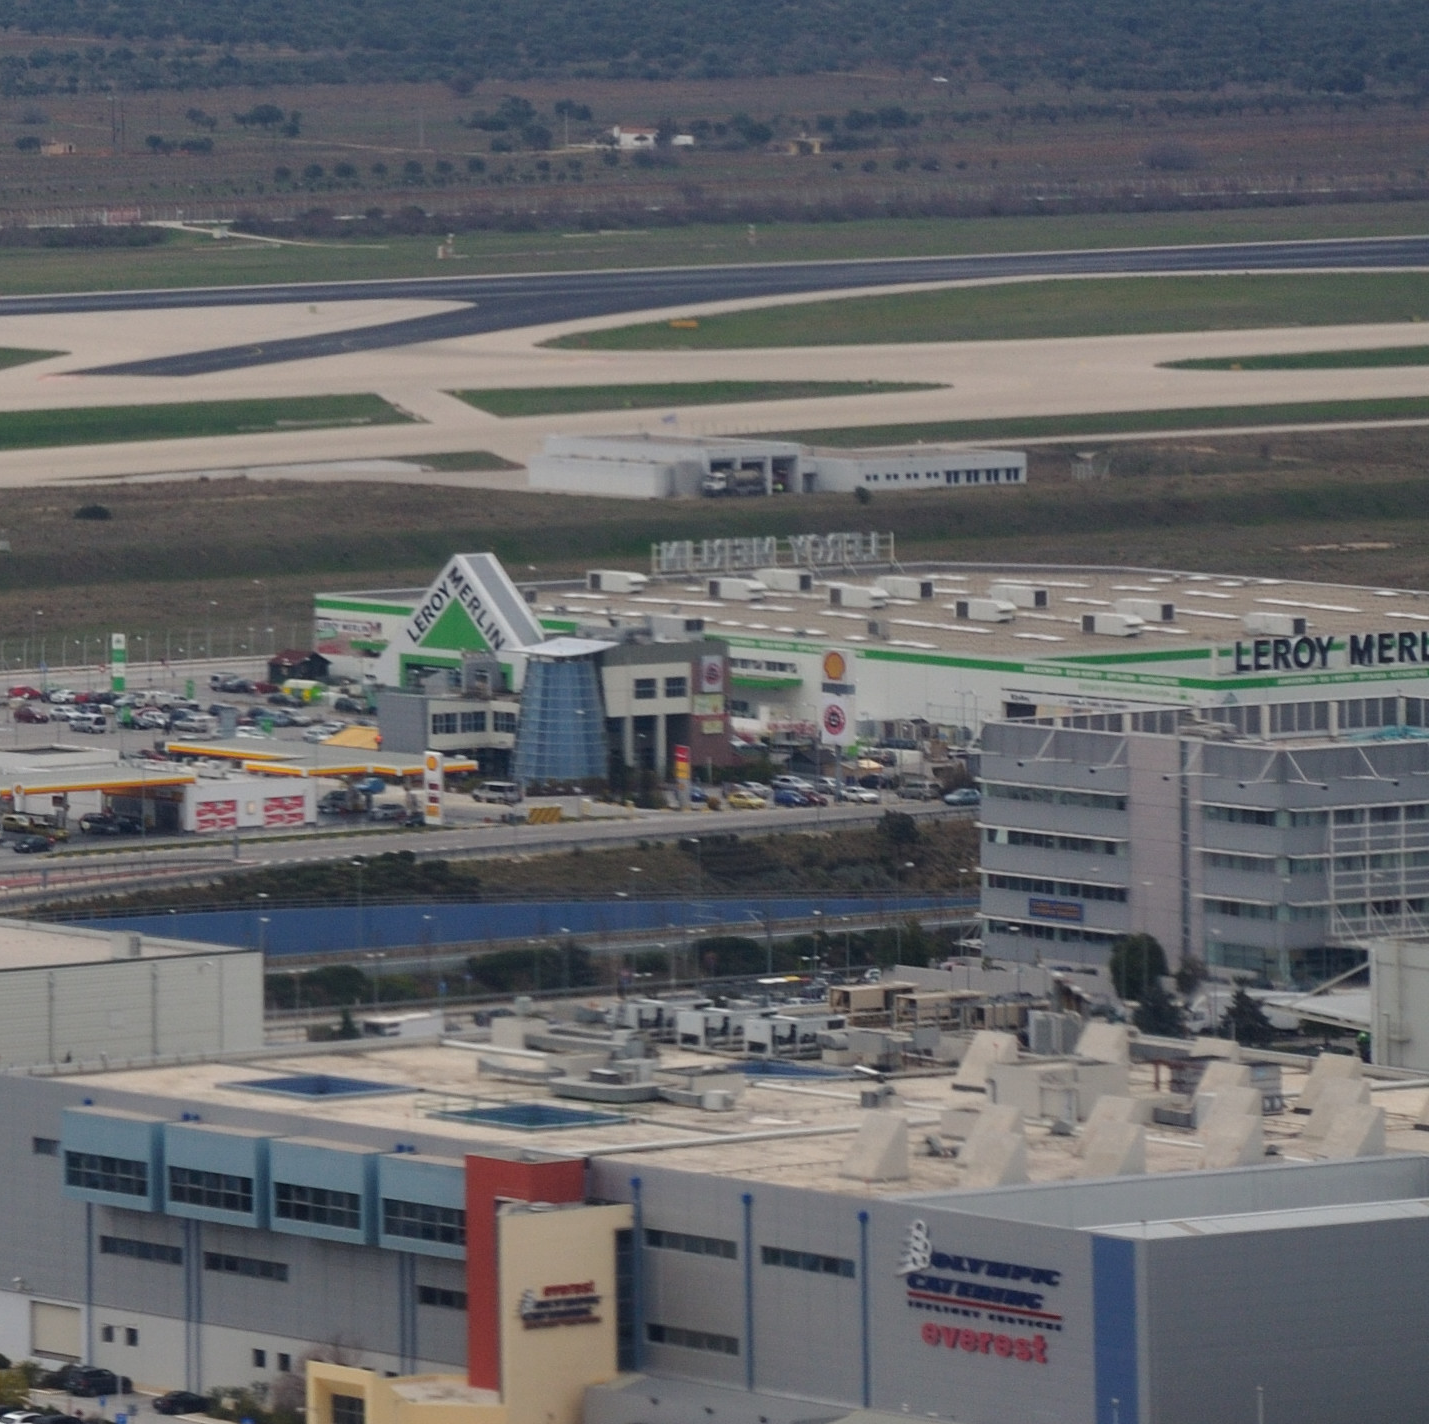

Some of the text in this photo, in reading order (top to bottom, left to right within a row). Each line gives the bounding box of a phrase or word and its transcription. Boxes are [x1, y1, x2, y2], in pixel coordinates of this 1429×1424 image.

[406, 565, 507, 652] LEROY MERLIN
[1235, 636, 1335, 672] LEROY
[921, 1322, 1048, 1364] everest
